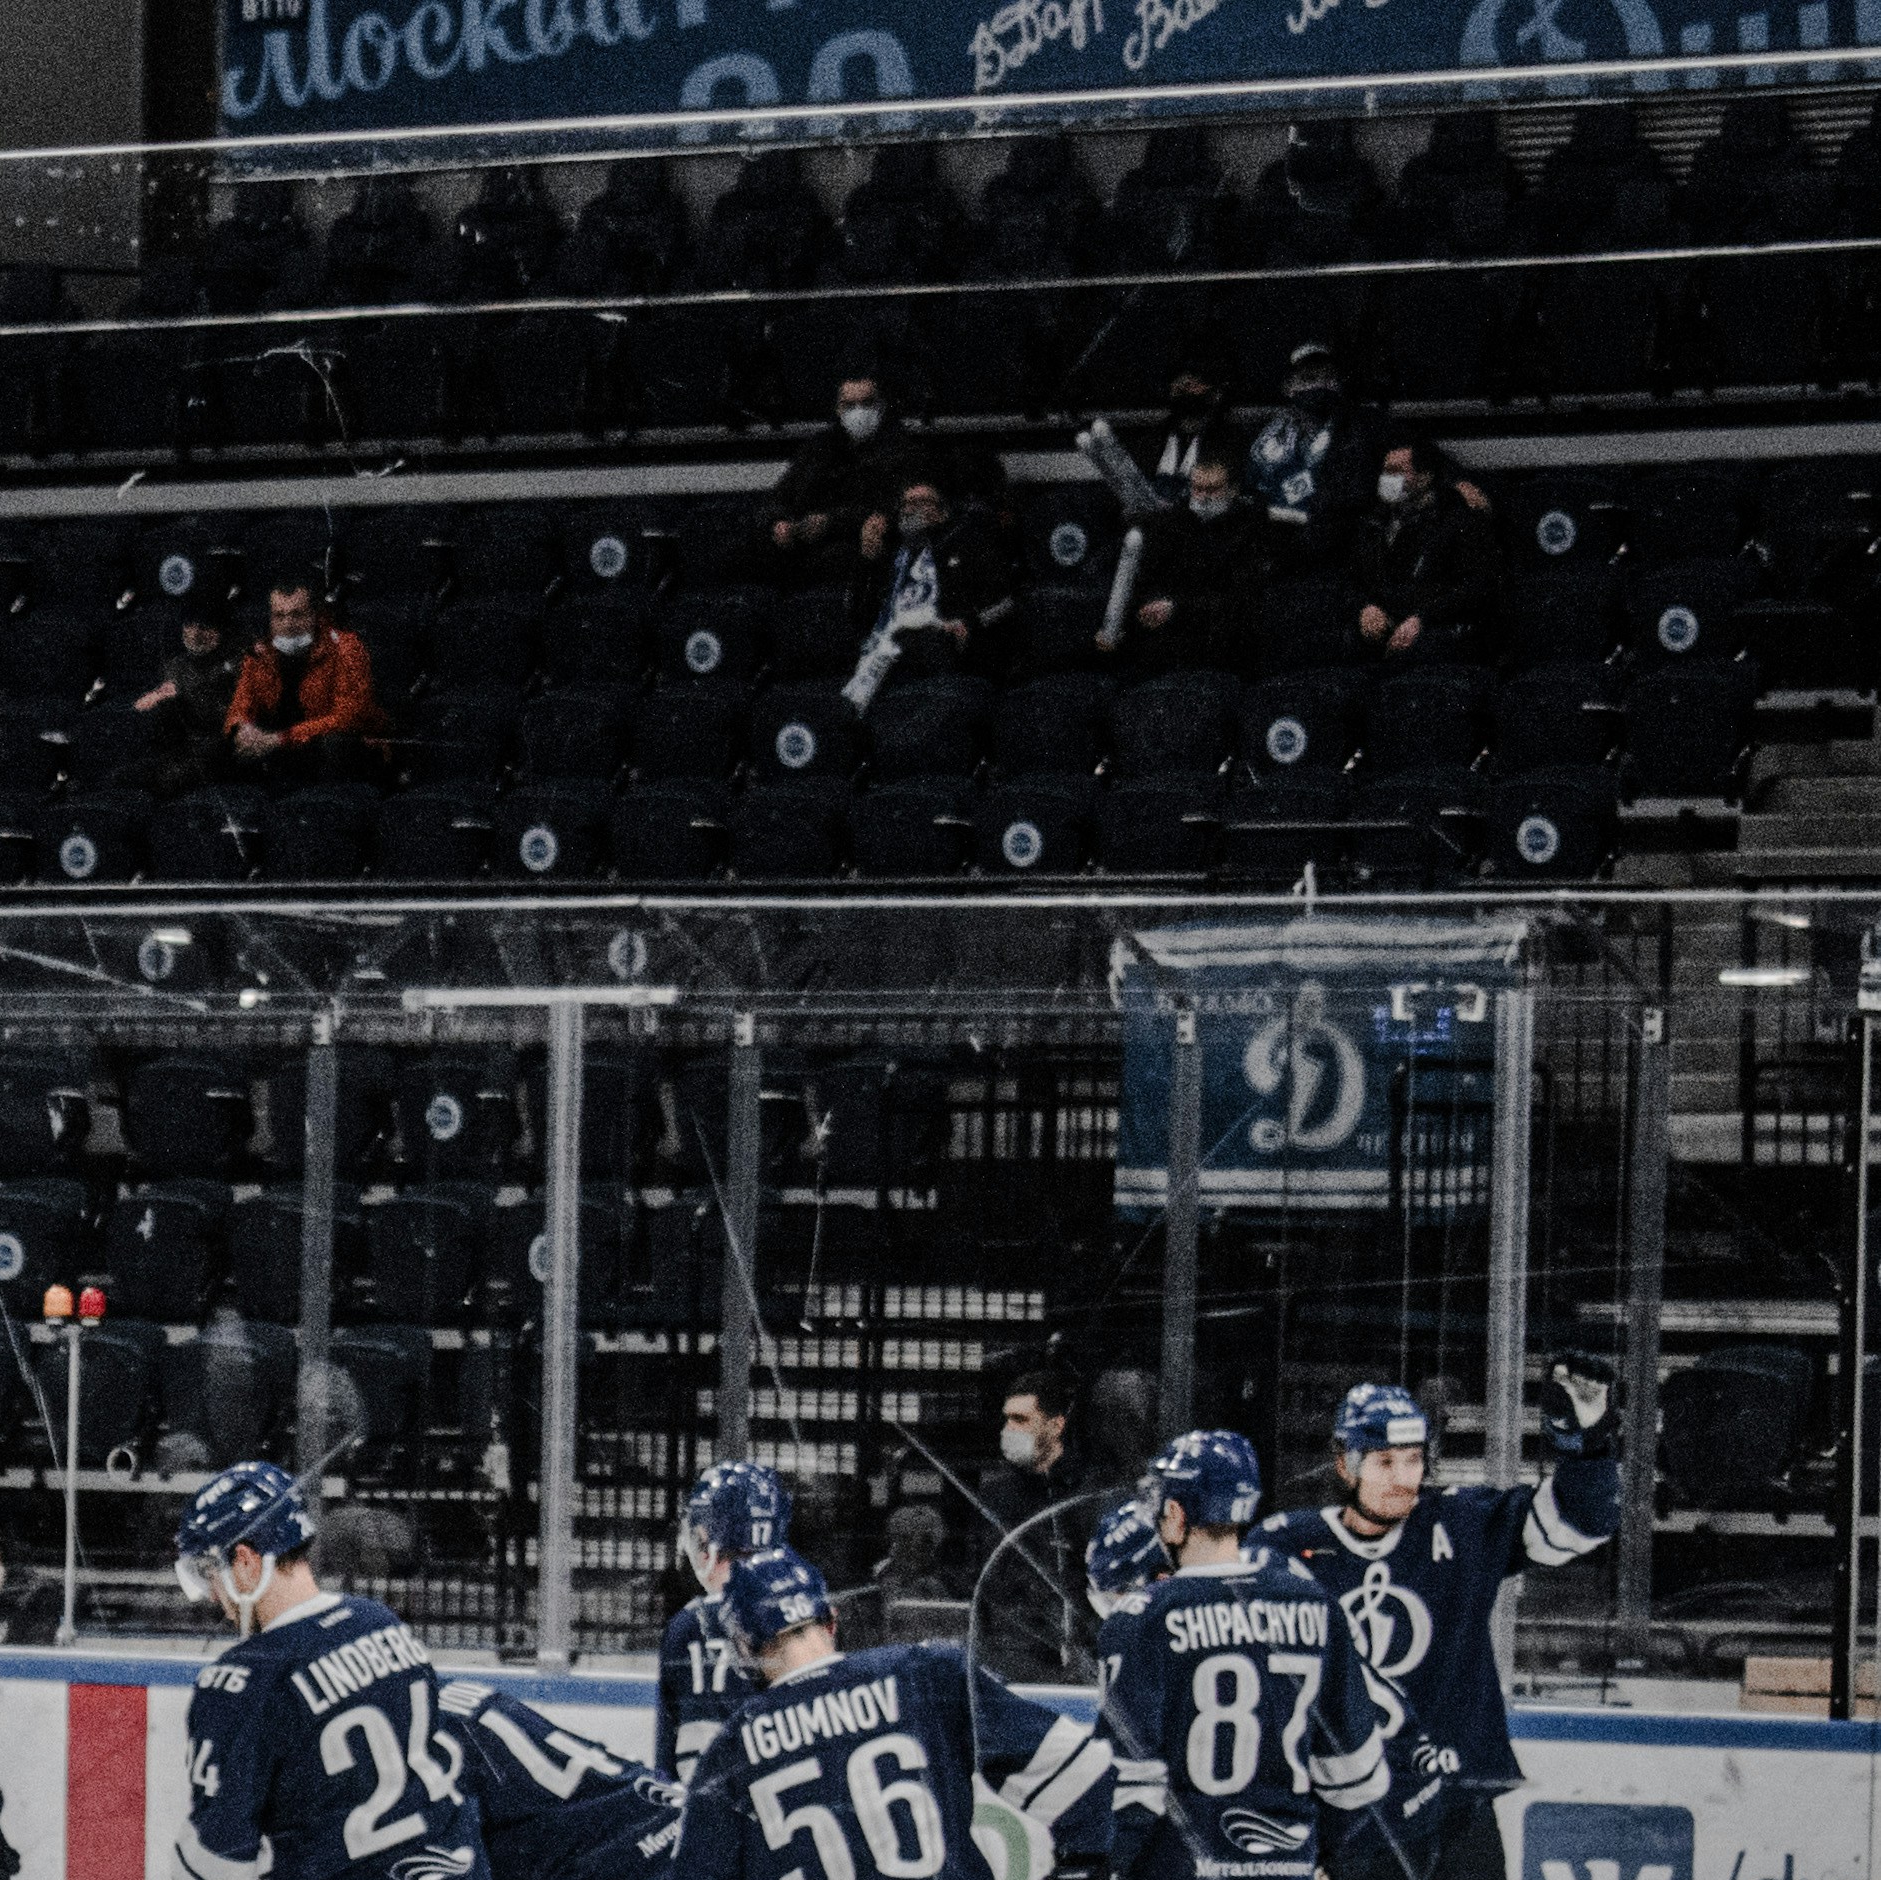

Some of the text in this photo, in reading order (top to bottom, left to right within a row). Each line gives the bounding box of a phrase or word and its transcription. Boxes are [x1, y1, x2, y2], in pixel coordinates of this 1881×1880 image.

[1432, 1522, 1453, 1562] A
[1165, 1600, 1329, 1654] SHIPACHYOV
[291, 1622, 429, 1716] LINDBERG
[687, 1639, 731, 1695] 17
[742, 1674, 900, 1766] IGUMNOV
[1185, 1653, 1323, 1797] 87
